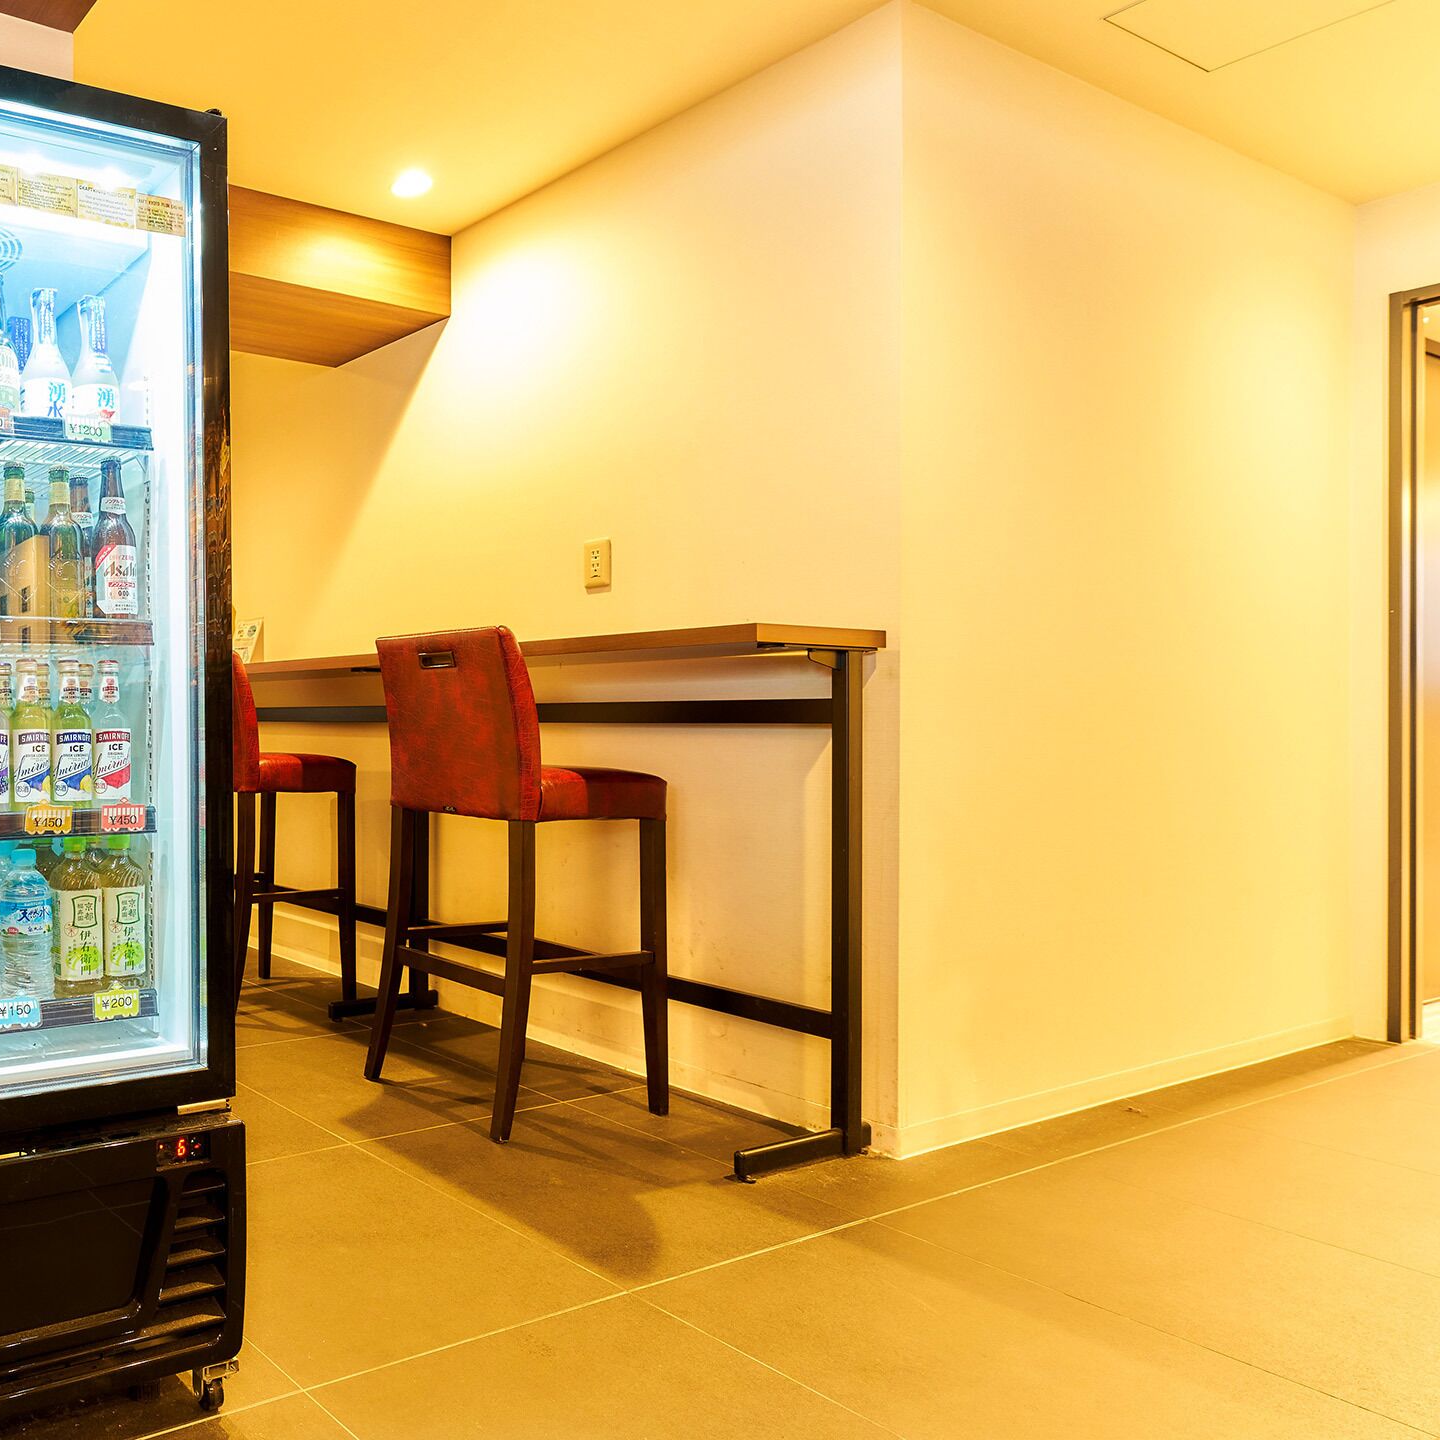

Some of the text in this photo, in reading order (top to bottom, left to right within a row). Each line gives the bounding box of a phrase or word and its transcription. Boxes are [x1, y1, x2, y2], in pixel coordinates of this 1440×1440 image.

[34, 816, 63, 828] ¥450
[109, 815, 137, 825] ¥450
[17, 906, 50, 922] 天然水
[102, 996, 132, 1009] ¥200
[177, 1138, 186, 1156] 6
